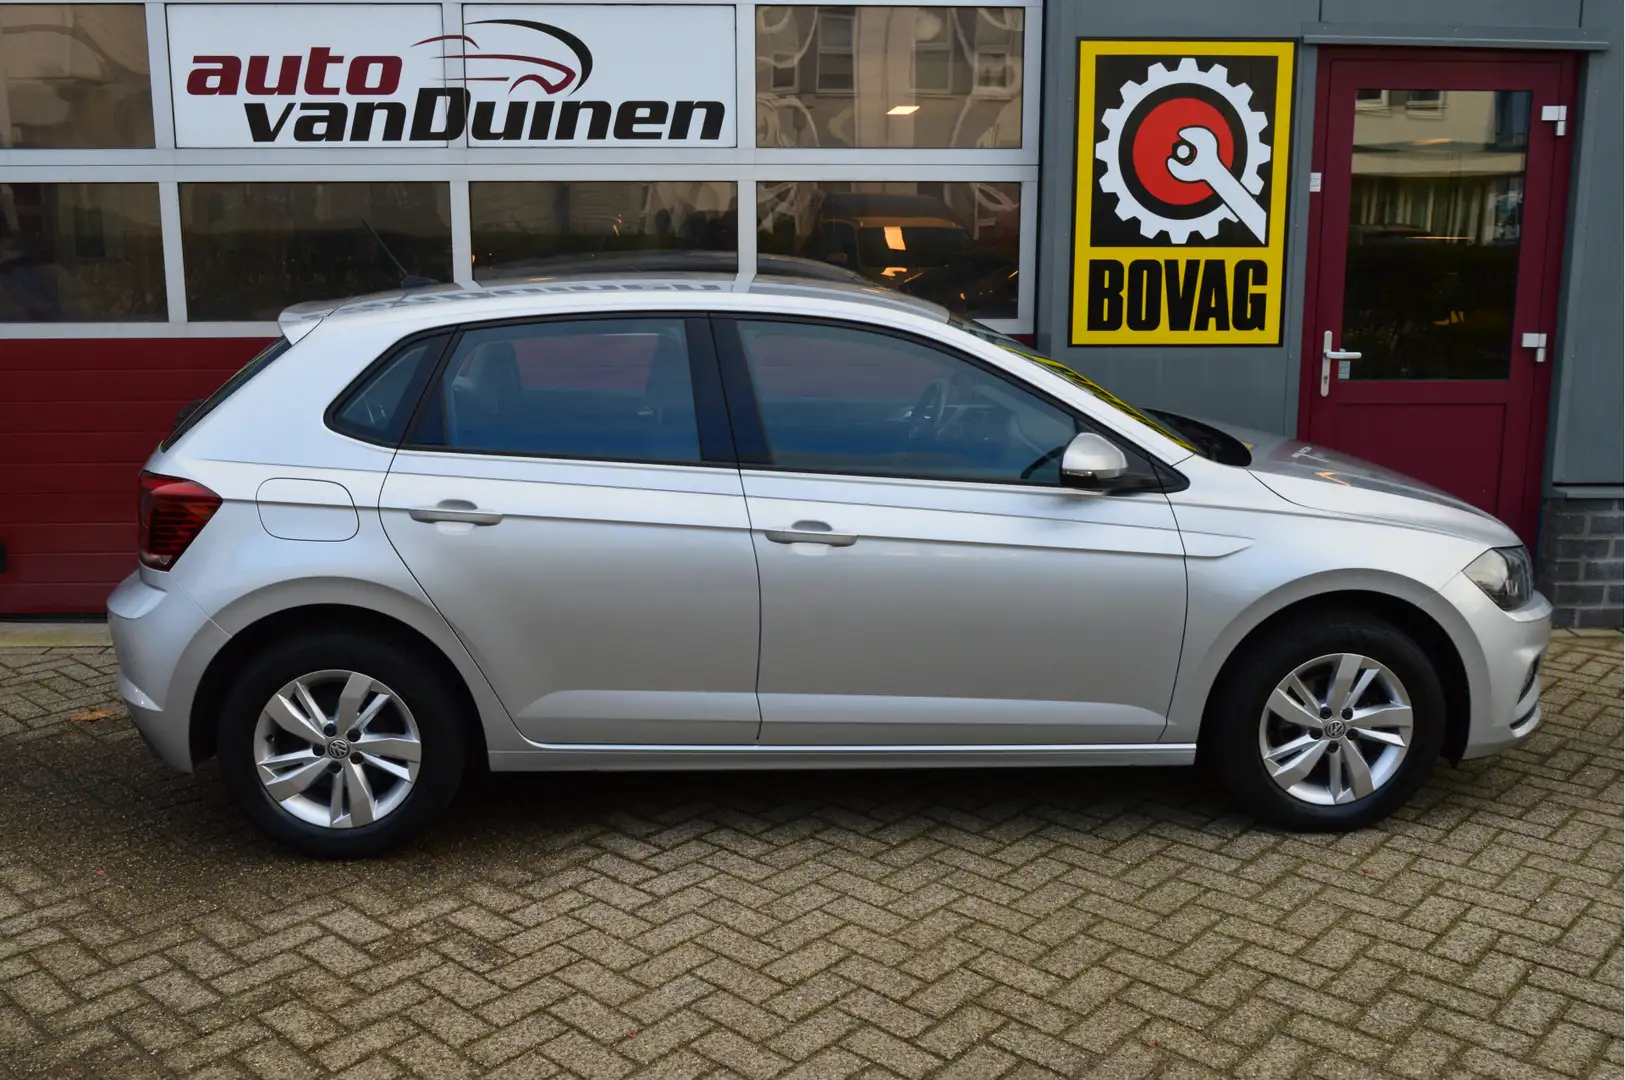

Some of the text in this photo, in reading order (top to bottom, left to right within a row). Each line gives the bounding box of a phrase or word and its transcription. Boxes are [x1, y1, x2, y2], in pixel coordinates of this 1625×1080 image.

[187, 47, 403, 95] auto
[244, 87, 725, 142] vanDuinen
[1087, 259, 1268, 331] BOVAG
